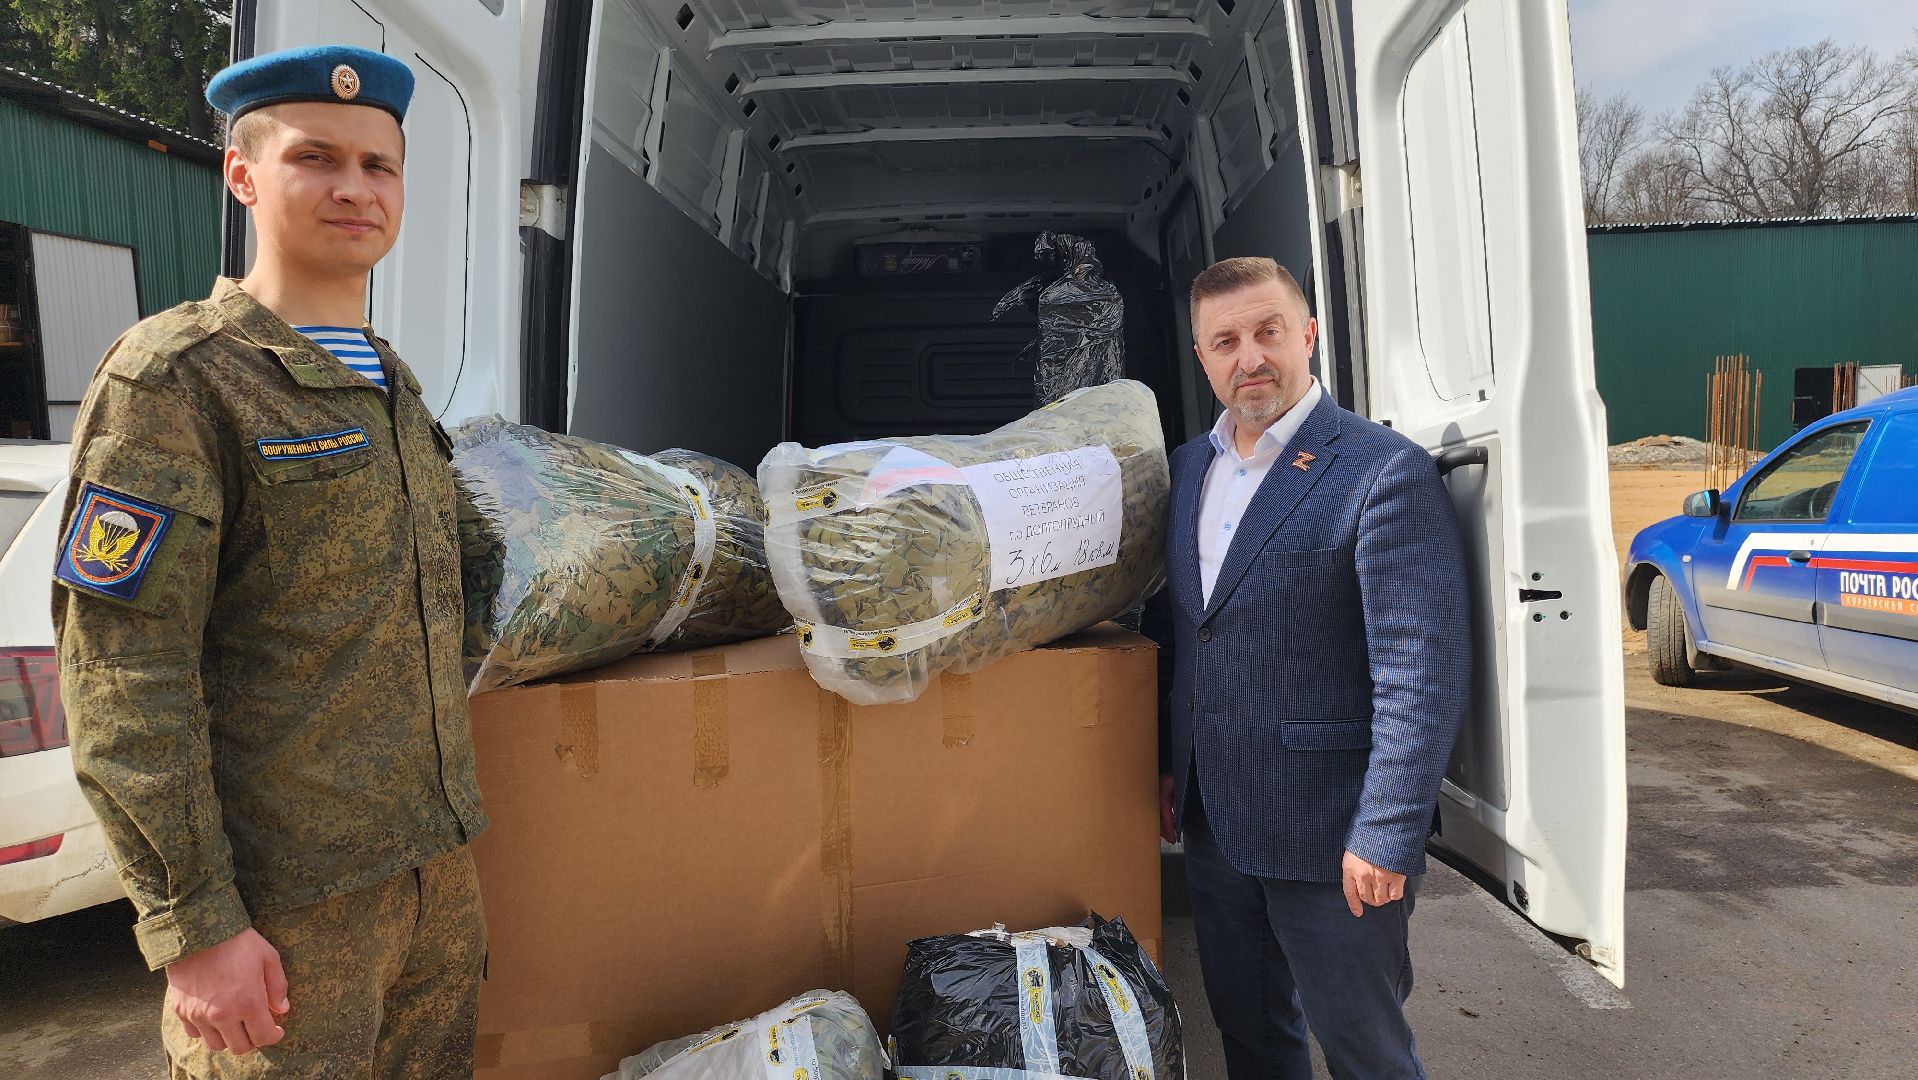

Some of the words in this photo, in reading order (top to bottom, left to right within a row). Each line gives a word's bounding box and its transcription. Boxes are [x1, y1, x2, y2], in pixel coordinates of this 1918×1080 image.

[261, 442, 319, 456] ВООРУЖЕННЫЕ
[318, 438, 339, 451] СИЛЫ
[337, 432, 365, 446] РОССИИ
[993, 459, 1084, 482] ОБЩЕСТВЕННАЯ
[1008, 475, 1086, 499] ОРГАНИЗАЦИЯ
[1021, 496, 1080, 517] ВЕТЕРАНОВ
[1026, 508, 1106, 540] ДОЛГОПРУДНЫЙ
[1840, 571, 1887, 597] ПОЧТА
[1846, 596, 1903, 612] КУРЬЕРСКАЯ
